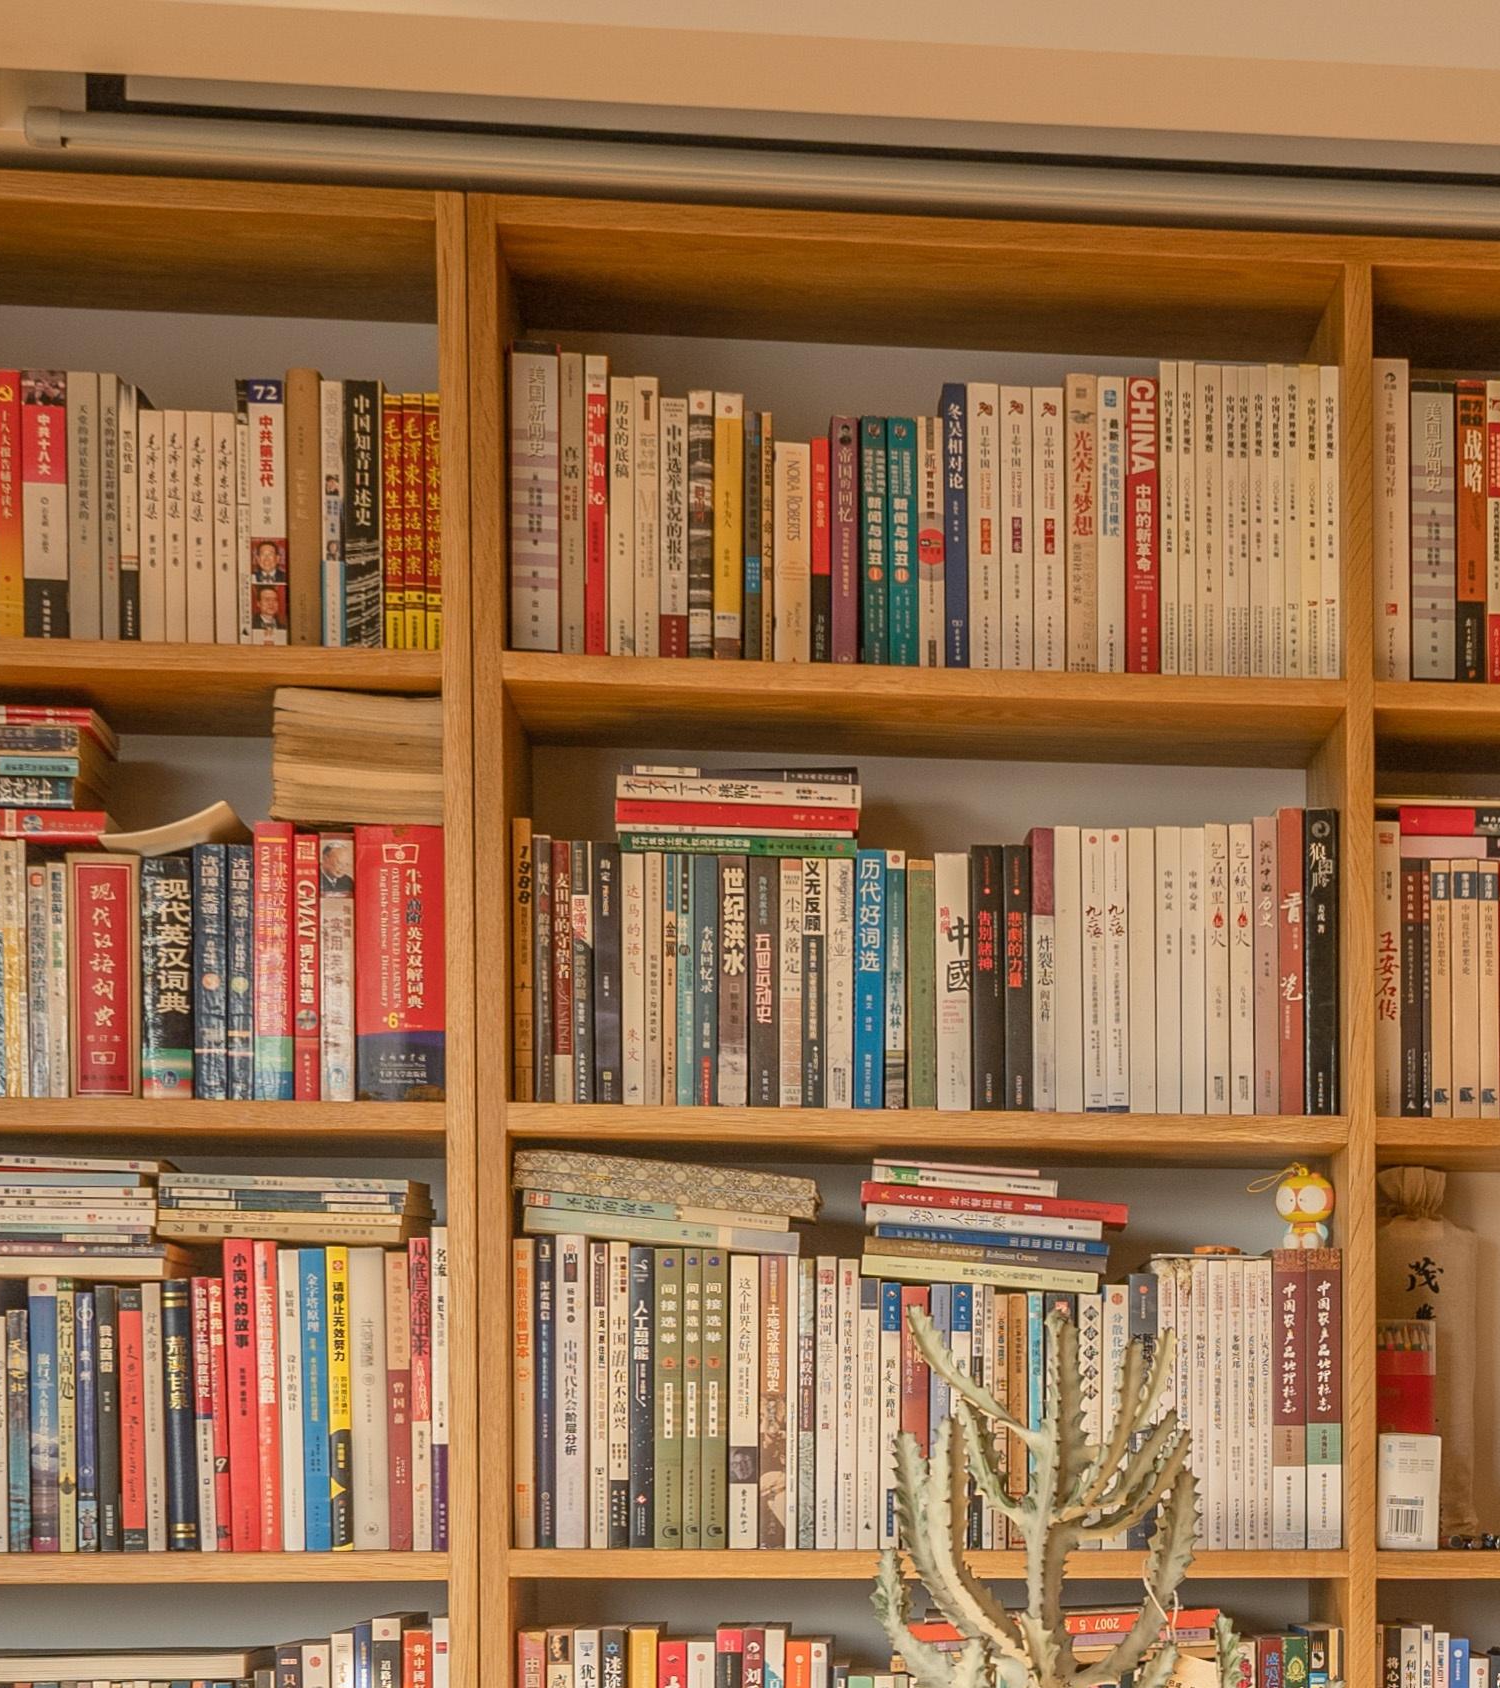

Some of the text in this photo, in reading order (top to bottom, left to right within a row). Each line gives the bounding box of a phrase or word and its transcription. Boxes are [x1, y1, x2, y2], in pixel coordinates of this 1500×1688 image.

[255, 387, 277, 400] 72
[259, 415, 274, 486] 中共第五代
[1130, 382, 1155, 572] CHINA 中国的新革命
[787, 495, 802, 542] ROBERTS
[299, 881, 315, 941] GMAT
[517, 844, 530, 903] 1988
[803, 859, 821, 934] 义无反顾
[157, 880, 191, 1016] 现代英汉词典
[722, 868, 745, 976] 世纪洪水
[858, 859, 881, 971] 历代好词选
[89, 883, 116, 1028] 现代汉语词典
[755, 933, 771, 1023] 五四运动史
[1037, 937, 1054, 986] 炸裂志
[233, 1253, 250, 1349] 小岗村的故事
[660, 1284, 676, 1345] 间接选举
